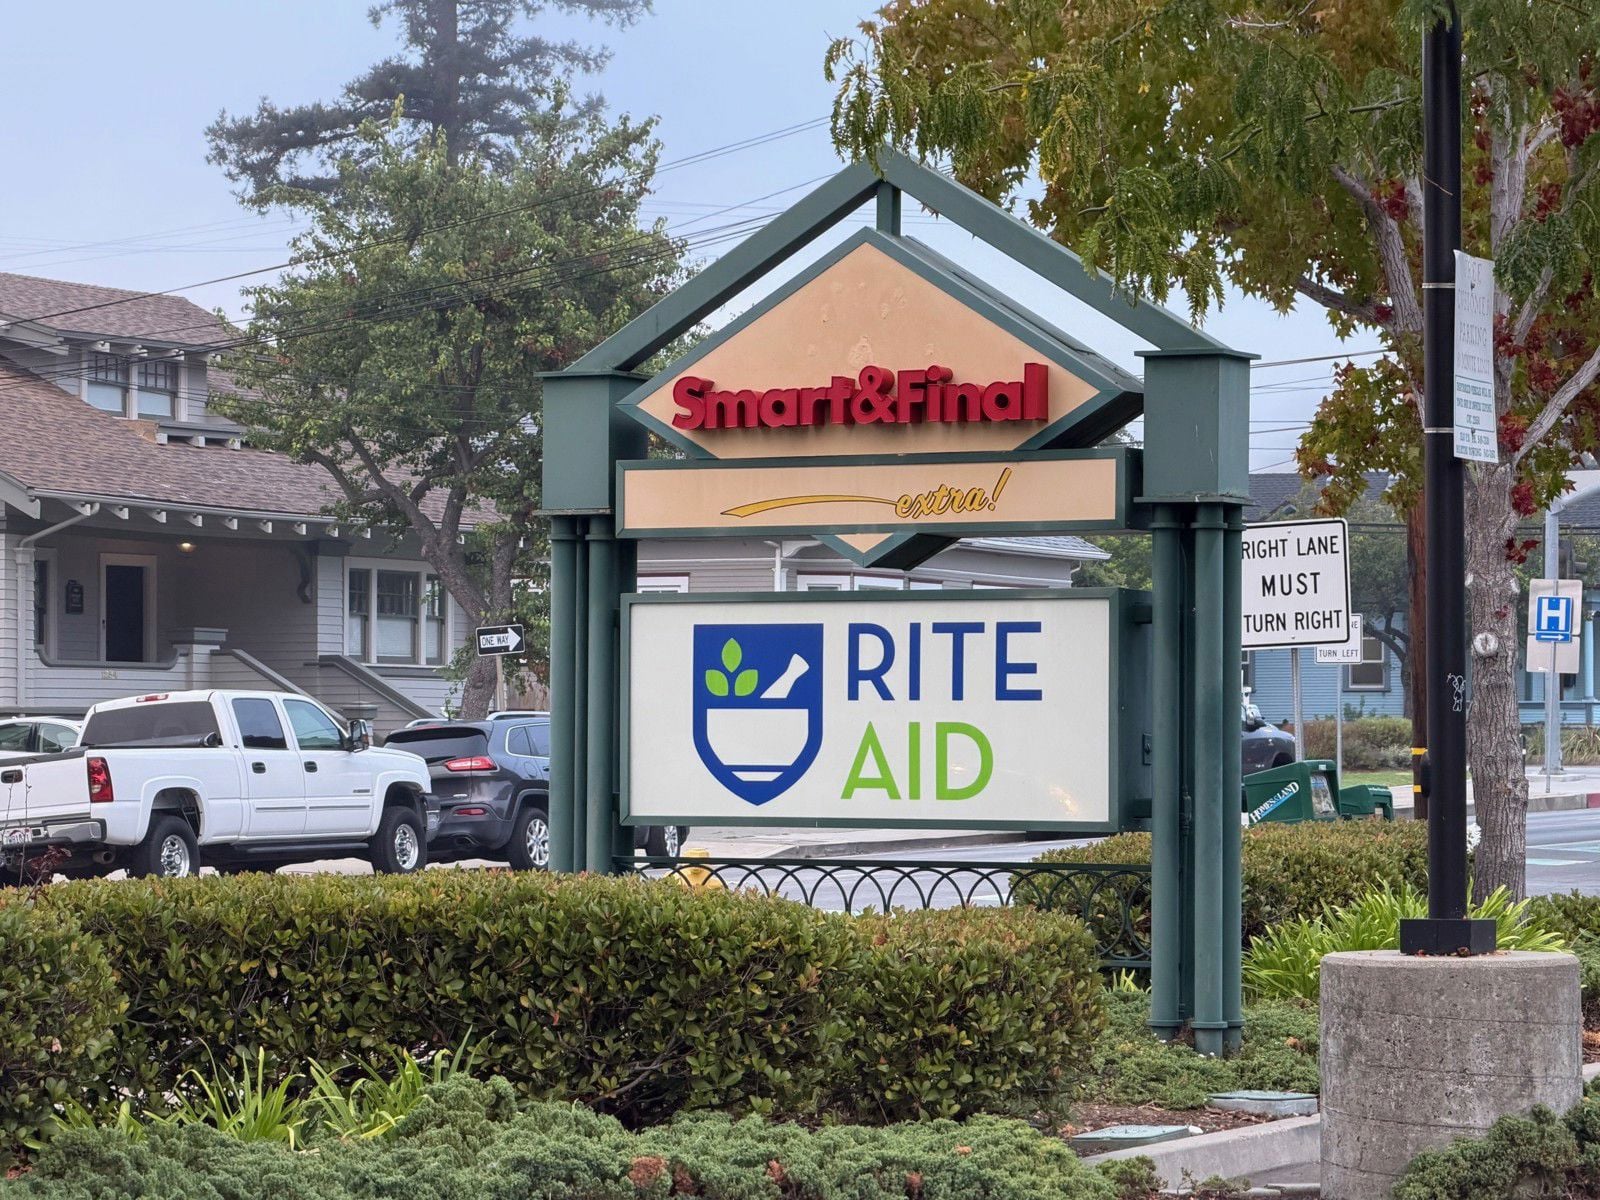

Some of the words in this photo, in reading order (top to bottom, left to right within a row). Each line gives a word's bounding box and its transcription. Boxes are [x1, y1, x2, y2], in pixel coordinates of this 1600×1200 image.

[672, 363, 1049, 430] Smart&Final
[895, 467, 1012, 518] extra!
[1241, 539, 1288, 560] RIGHT
[1297, 536, 1340, 556] LANE
[1261, 572, 1320, 597] MUST
[1243, 612, 1287, 633] TURN
[1294, 610, 1342, 630] RIGHT
[1540, 598, 1567, 631] H
[481, 636, 495, 646] ONE
[496, 635, 509, 645] WAY
[1319, 649, 1338, 658] TURN
[1342, 649, 1359, 657] LEFT
[847, 621, 1043, 701] RITE
[840, 720, 994, 800] AID
